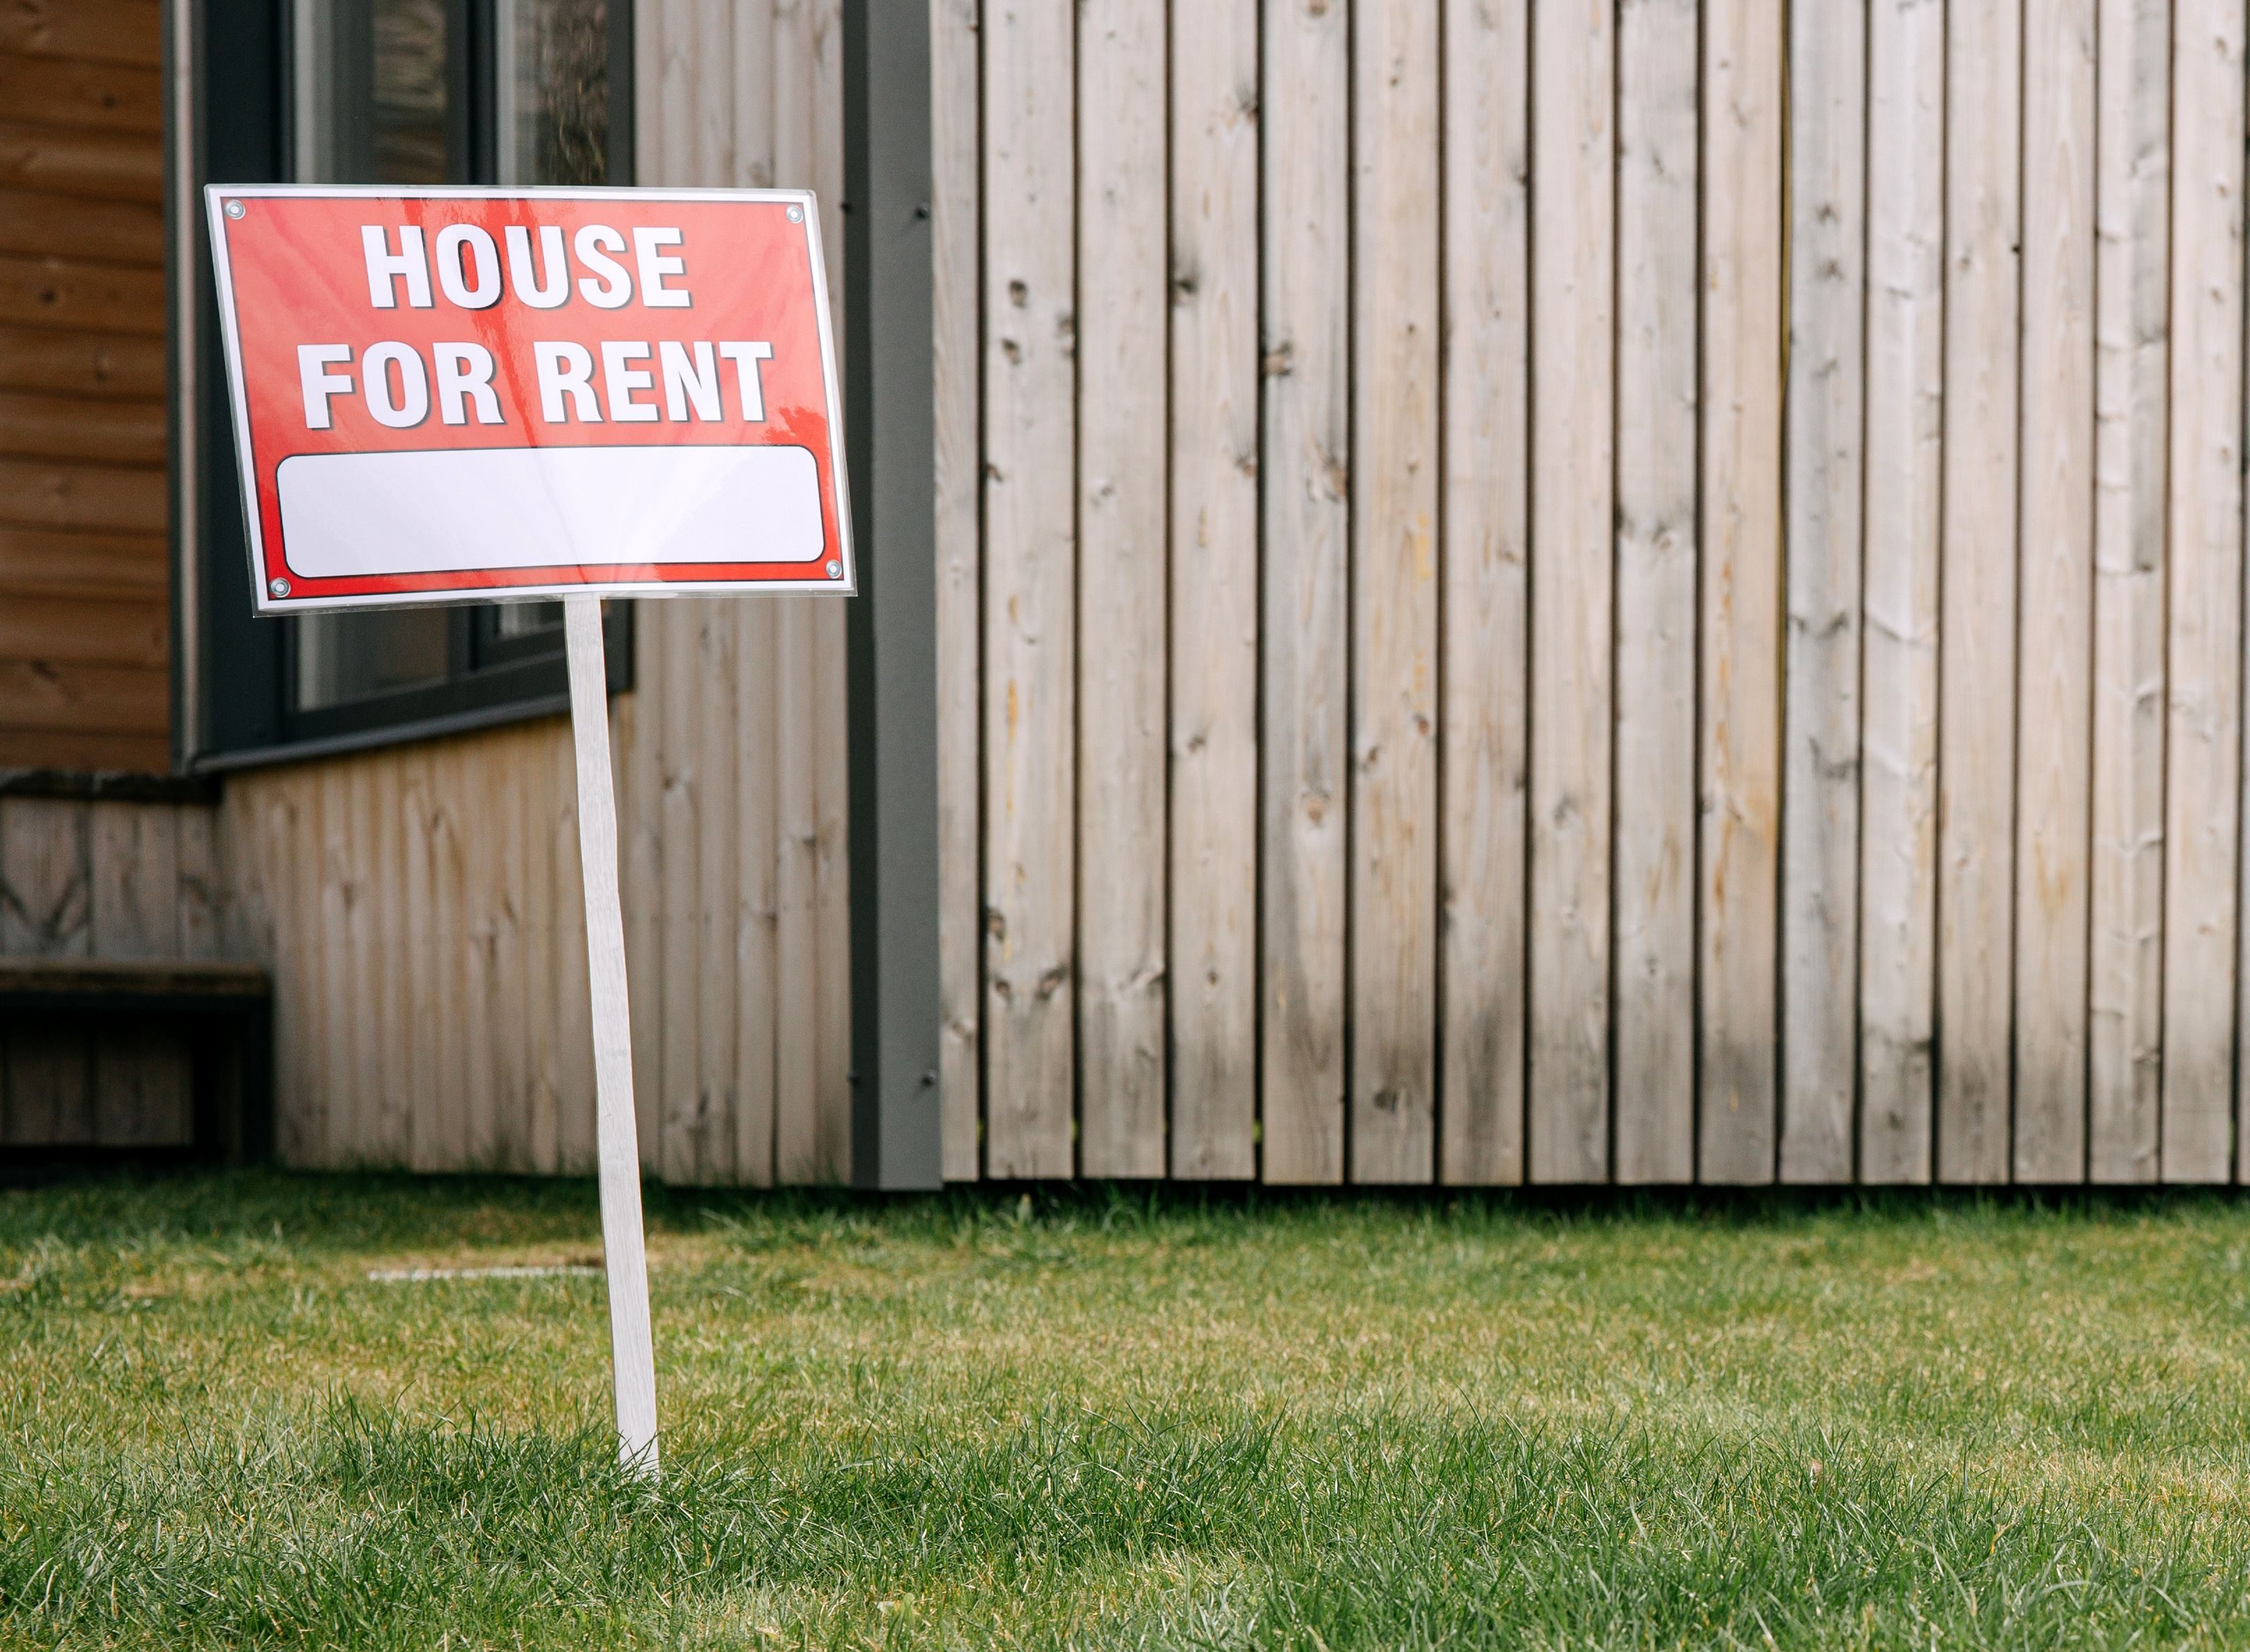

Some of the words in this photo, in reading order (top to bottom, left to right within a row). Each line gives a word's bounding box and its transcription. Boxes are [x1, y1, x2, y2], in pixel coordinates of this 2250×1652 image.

[360, 224, 692, 309] HOUSE
[296, 340, 505, 429] FOR
[533, 340, 773, 423] RENT
